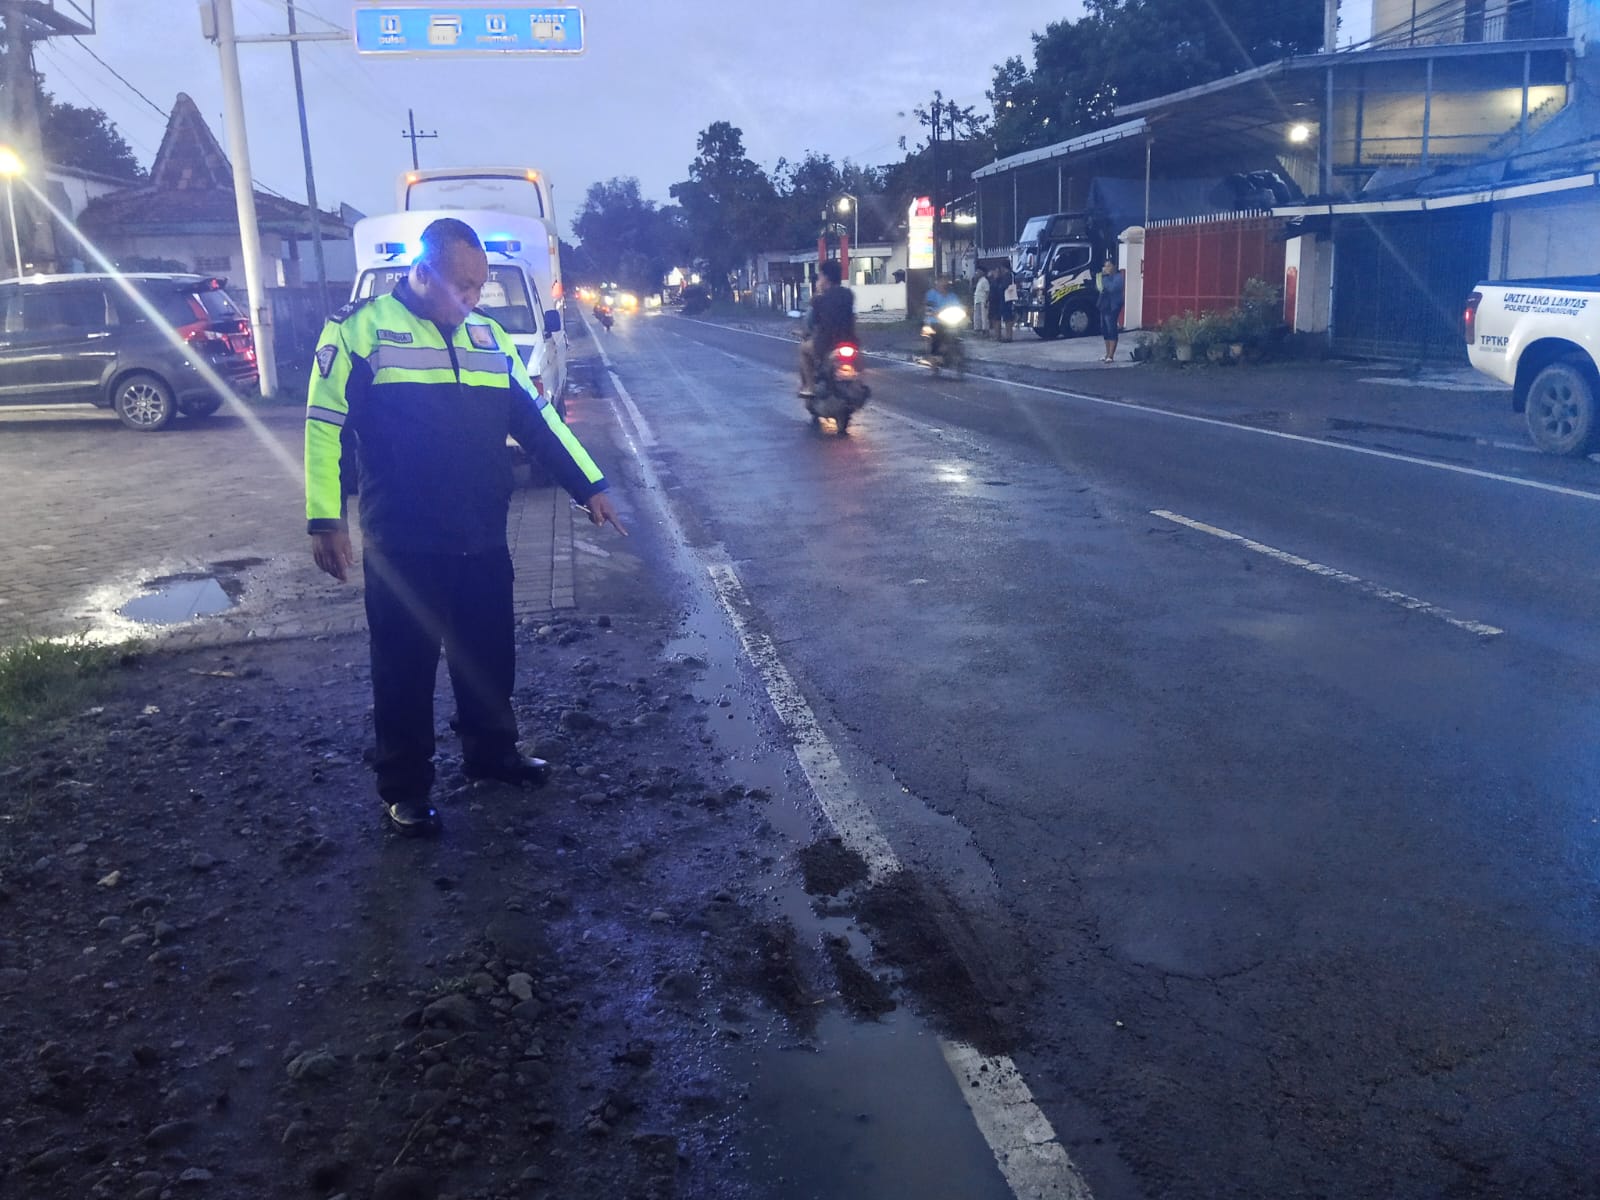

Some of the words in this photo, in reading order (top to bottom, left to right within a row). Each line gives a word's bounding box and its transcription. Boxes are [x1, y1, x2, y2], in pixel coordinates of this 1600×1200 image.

[1504, 293, 1526, 303] UNIT
[1526, 294, 1549, 305] LAKA
[1551, 296, 1588, 308] LANTAS
[1504, 304, 1531, 313] POLRES
[1480, 335, 1509, 346] TPTKP
